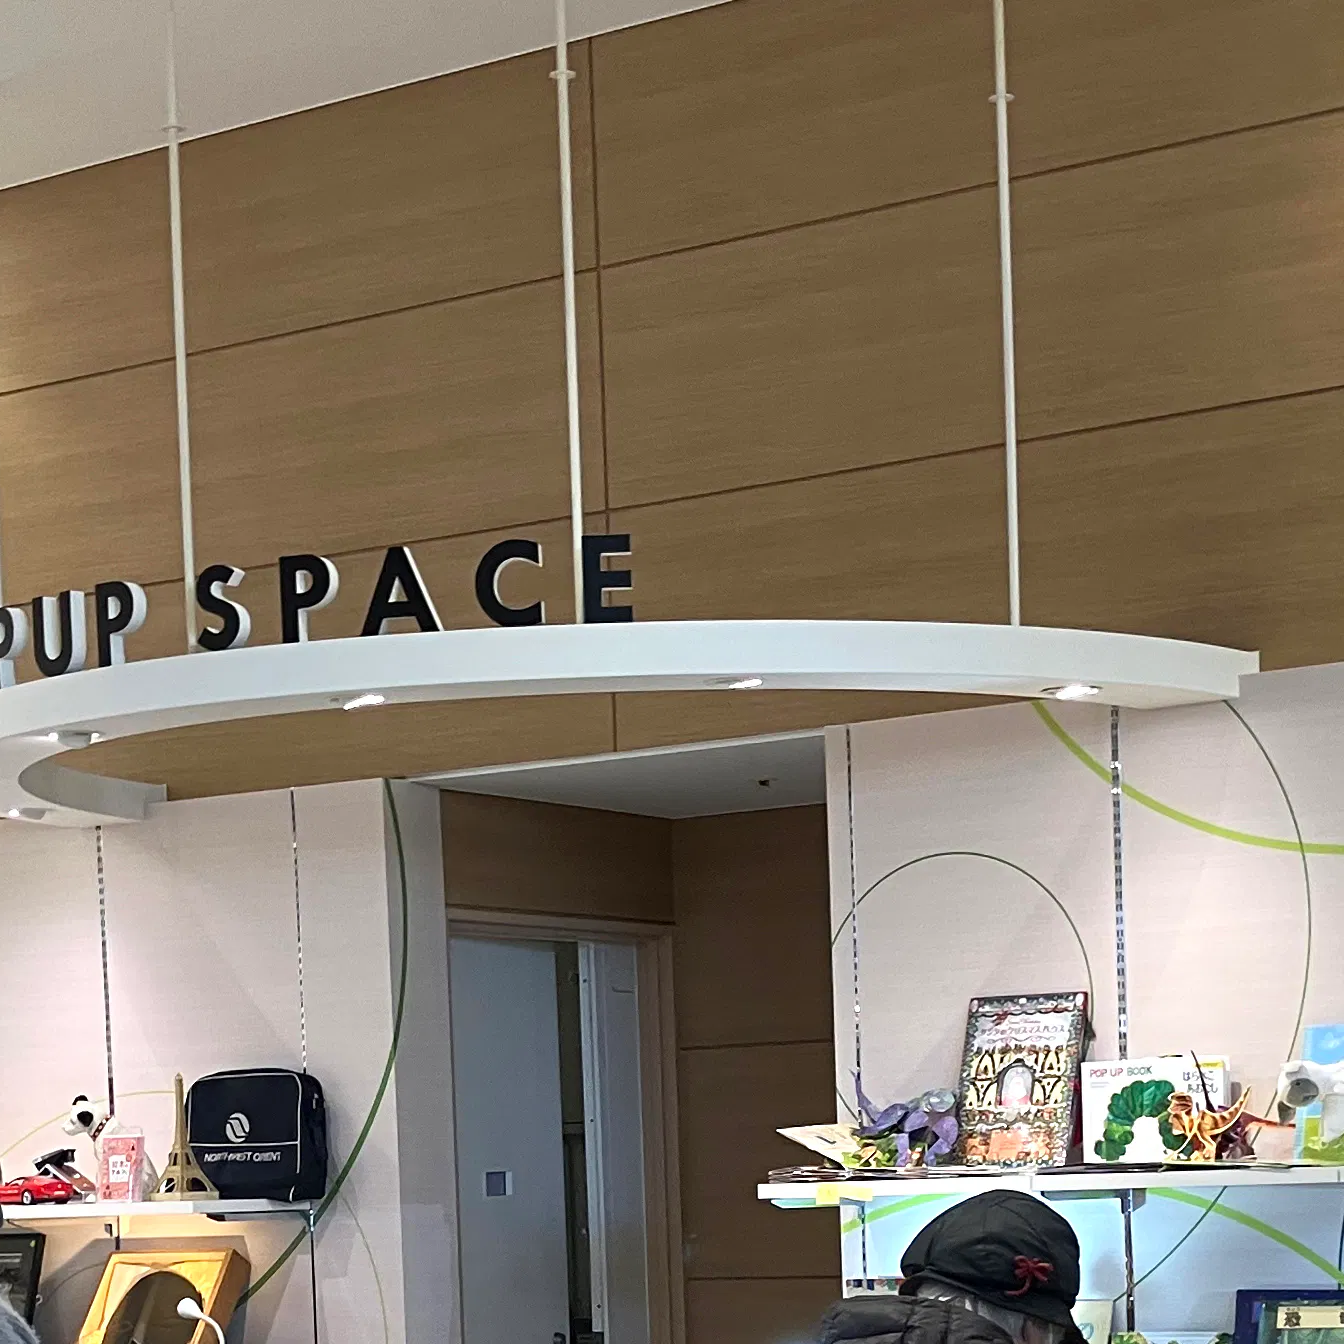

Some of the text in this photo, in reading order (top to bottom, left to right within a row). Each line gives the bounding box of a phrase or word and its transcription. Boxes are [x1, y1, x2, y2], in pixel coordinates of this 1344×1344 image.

[196, 534, 633, 651] SPACE
[1090, 1065, 1153, 1078] POP UP BOOK
